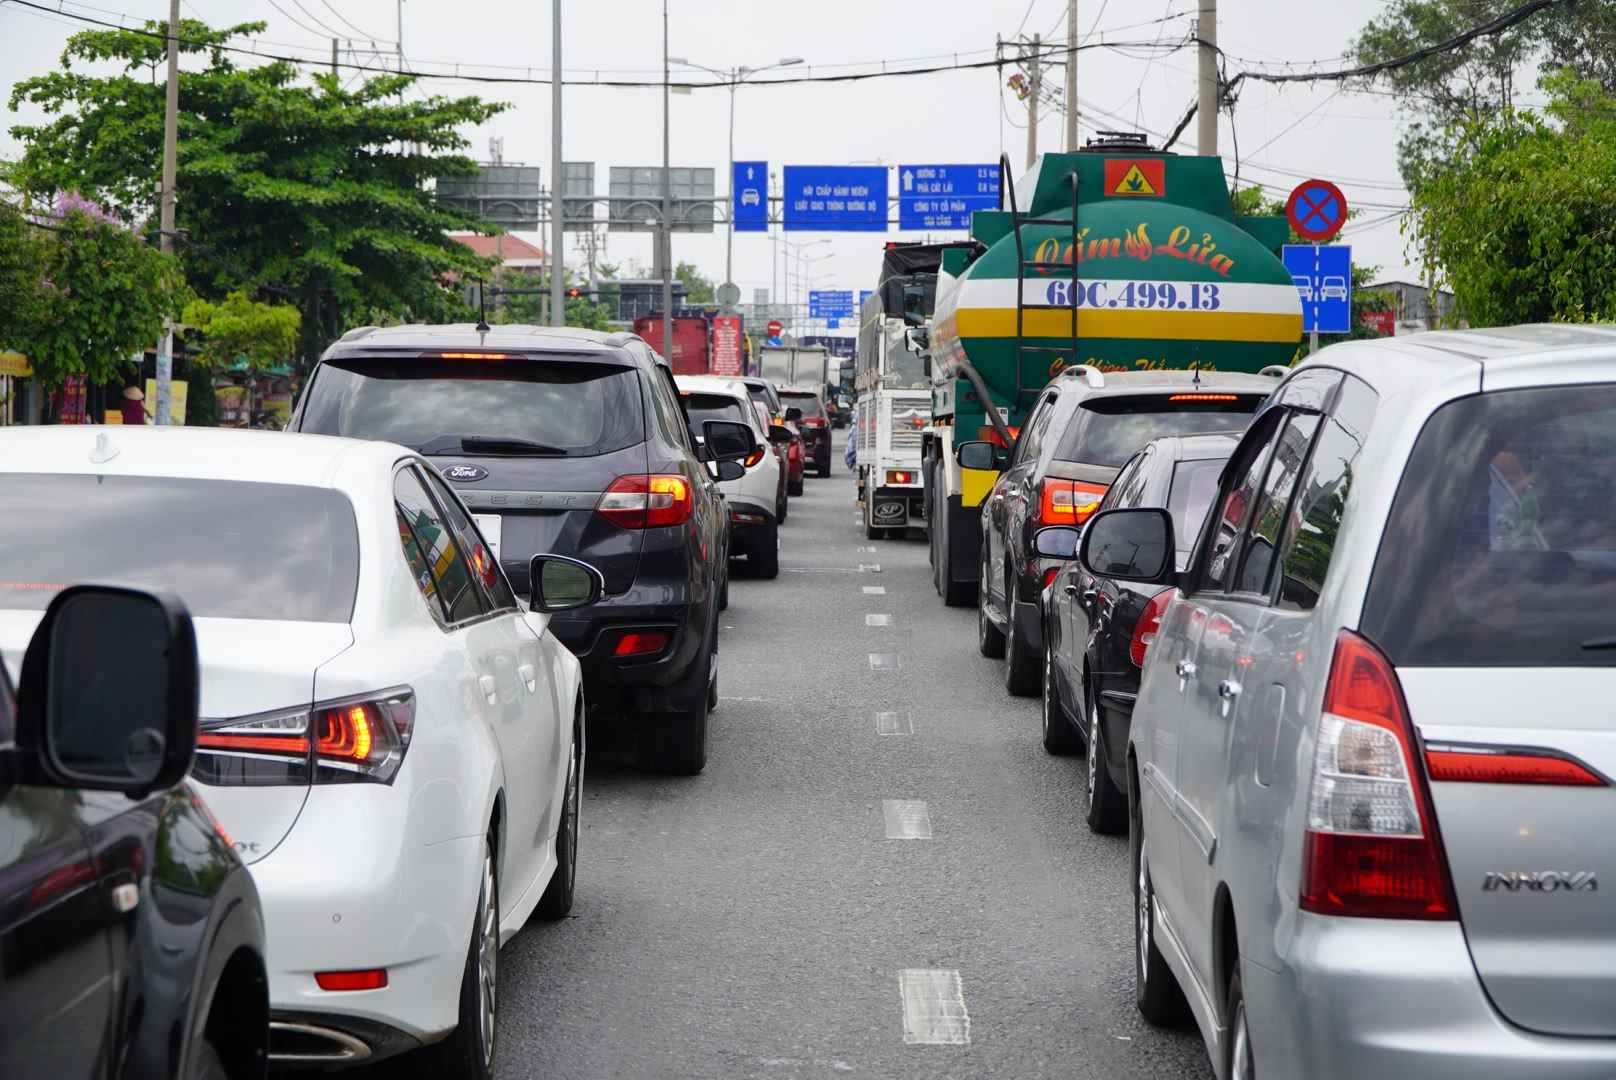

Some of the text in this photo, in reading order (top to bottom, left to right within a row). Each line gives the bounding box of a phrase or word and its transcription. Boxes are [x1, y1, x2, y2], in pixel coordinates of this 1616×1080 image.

[1155, 224, 1234, 278] Lửa
[1047, 280, 1220, 310] 60C.499.13
[451, 466, 478, 478] Ford
[1482, 871, 1598, 893] INNOVA
